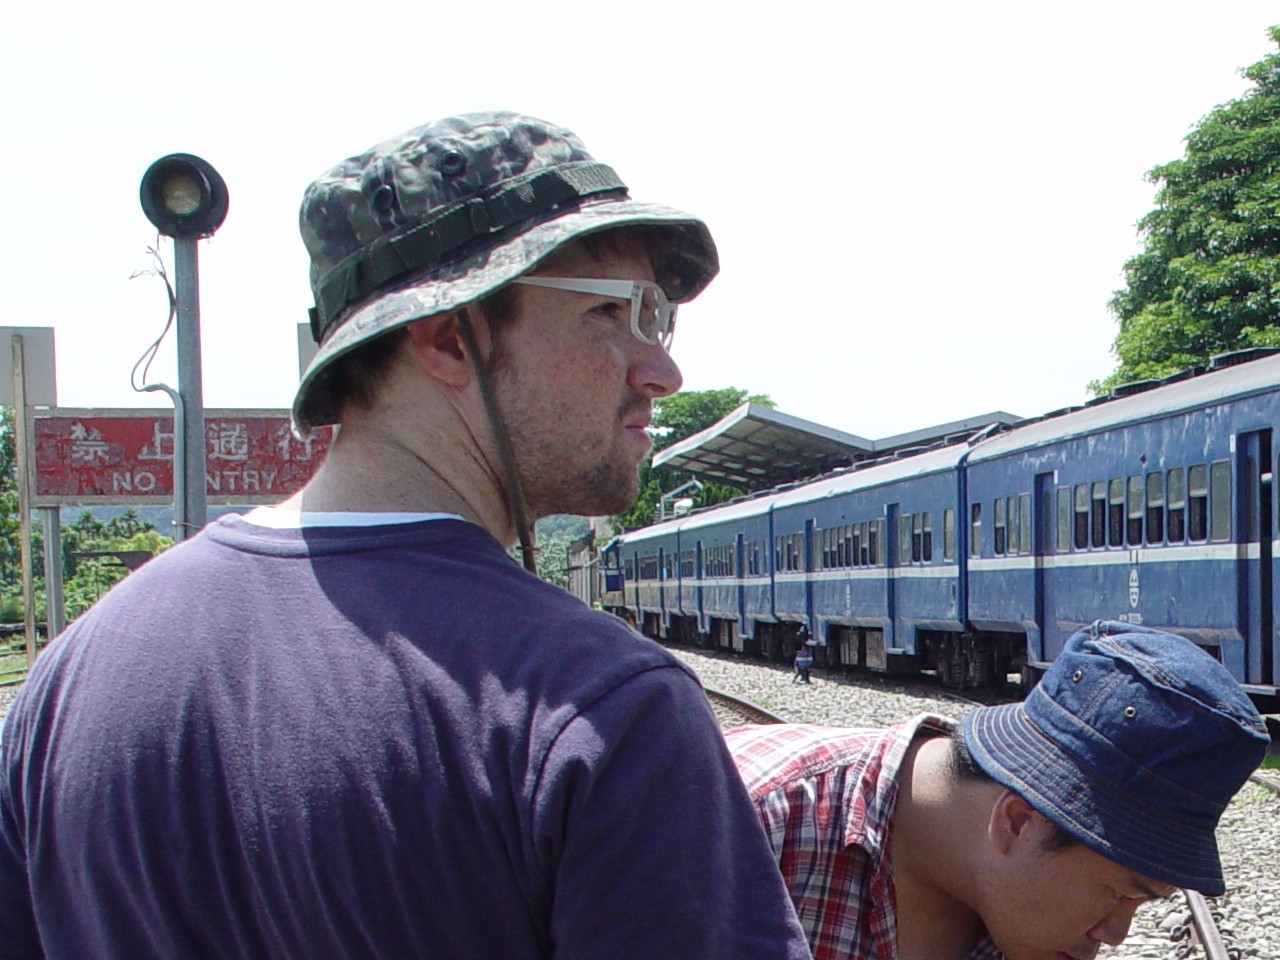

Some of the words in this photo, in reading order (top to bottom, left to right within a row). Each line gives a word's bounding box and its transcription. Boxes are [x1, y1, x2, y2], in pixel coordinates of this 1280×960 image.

[70, 422, 317, 462] 禁止通行
[112, 471, 156, 492] NO
[205, 469, 278, 491] NTRY
